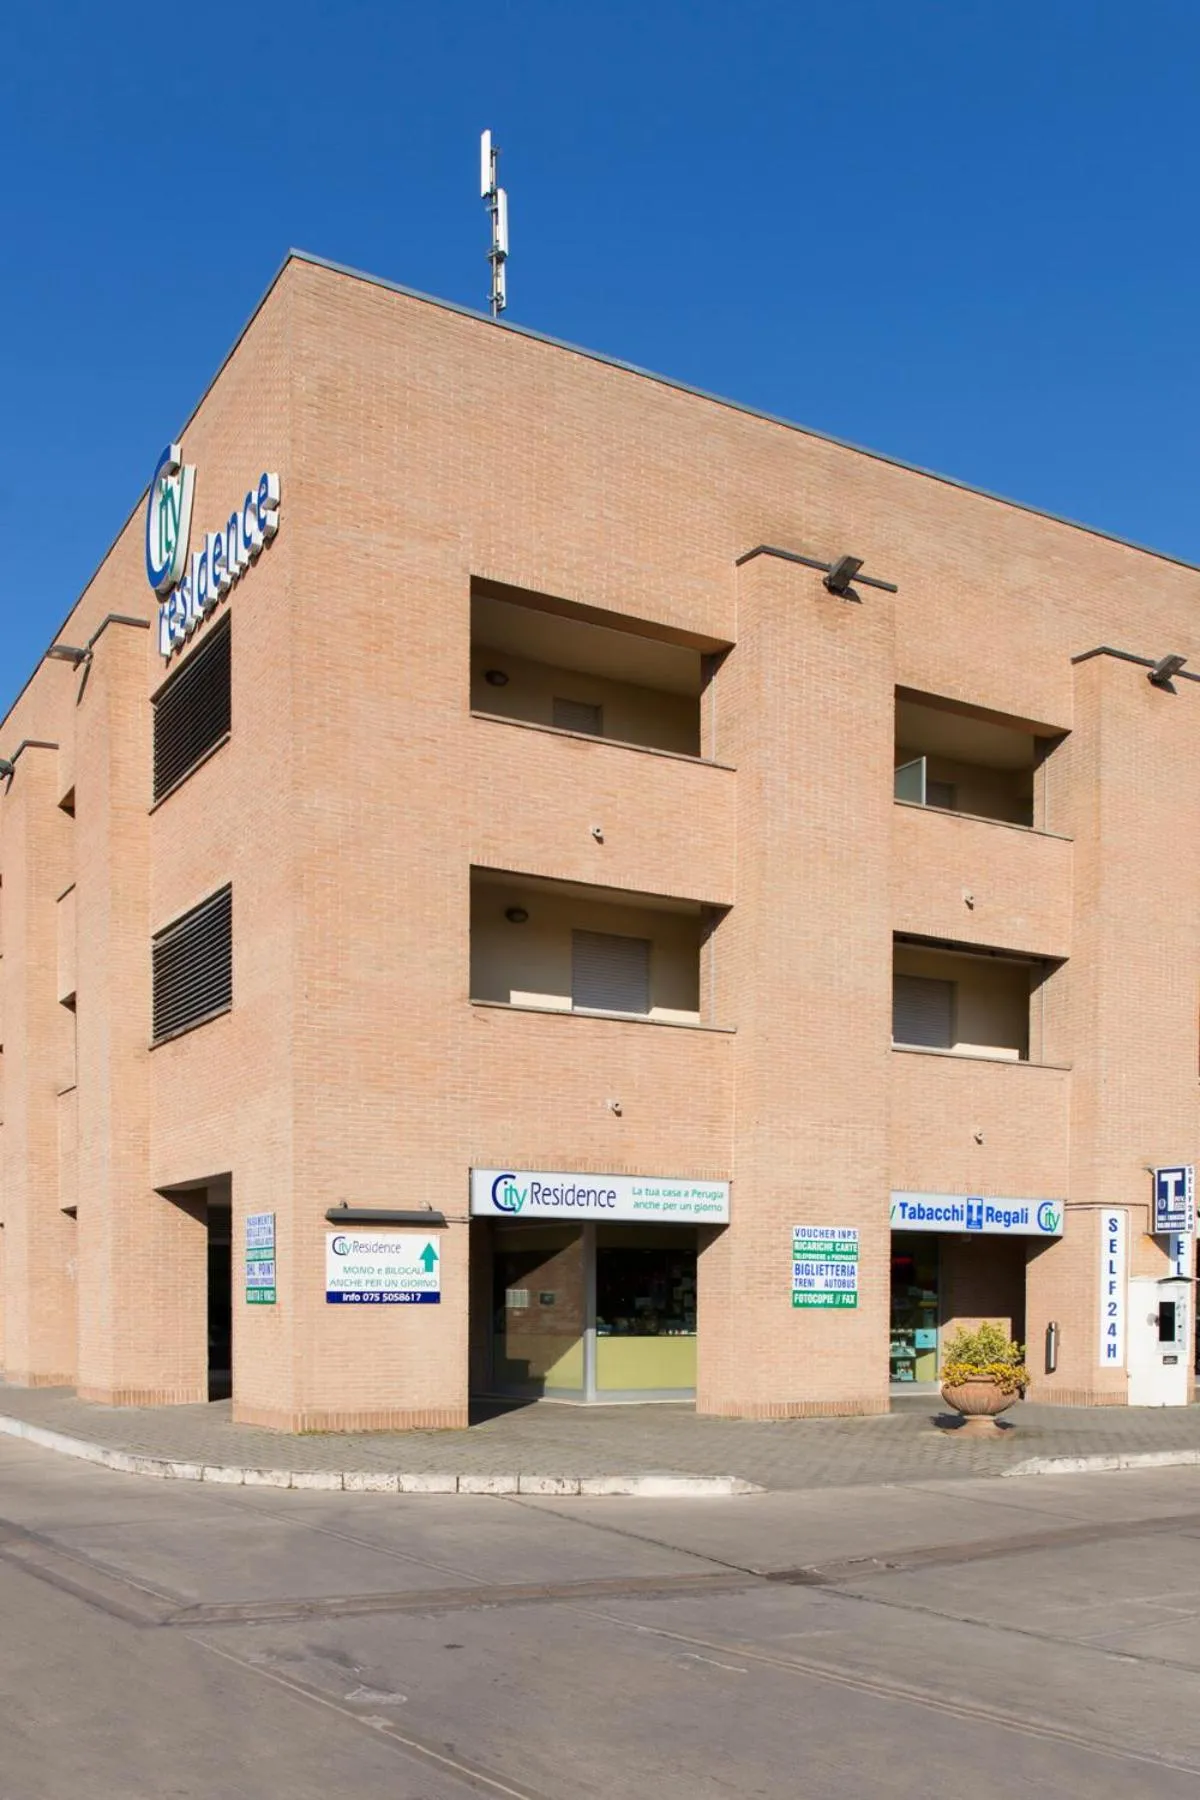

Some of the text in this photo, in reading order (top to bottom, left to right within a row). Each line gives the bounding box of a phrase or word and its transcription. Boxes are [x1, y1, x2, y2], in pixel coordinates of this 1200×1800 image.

[146, 443, 196, 594] City
[159, 472, 280, 657] residence
[491, 1174, 616, 1214] City Residence
[632, 1186, 643, 1195] La
[645, 1187, 660, 1197] tua
[662, 1189, 682, 1198] casa
[691, 1190, 724, 1202] Perugia
[633, 1199, 723, 1214] anche per un giorno
[899, 1202, 964, 1222] Tabacchi
[986, 1206, 1028, 1228] Regali
[1037, 1202, 1060, 1233] City
[795, 1228, 857, 1240] VOUCHER INPS
[332, 1235, 402, 1256] City Residence
[343, 1266, 375, 1274] MONO
[795, 1263, 855, 1276] BIGLIETTERIA
[330, 1279, 437, 1288] ANCHE PER UN GIORNO
[795, 1277, 856, 1288] TRENI AUTOBUS
[342, 1293, 422, 1302] Info 075 5058617
[795, 1292, 833, 1304] FOTOCOPIE
[842, 1294, 855, 1304] FAX
